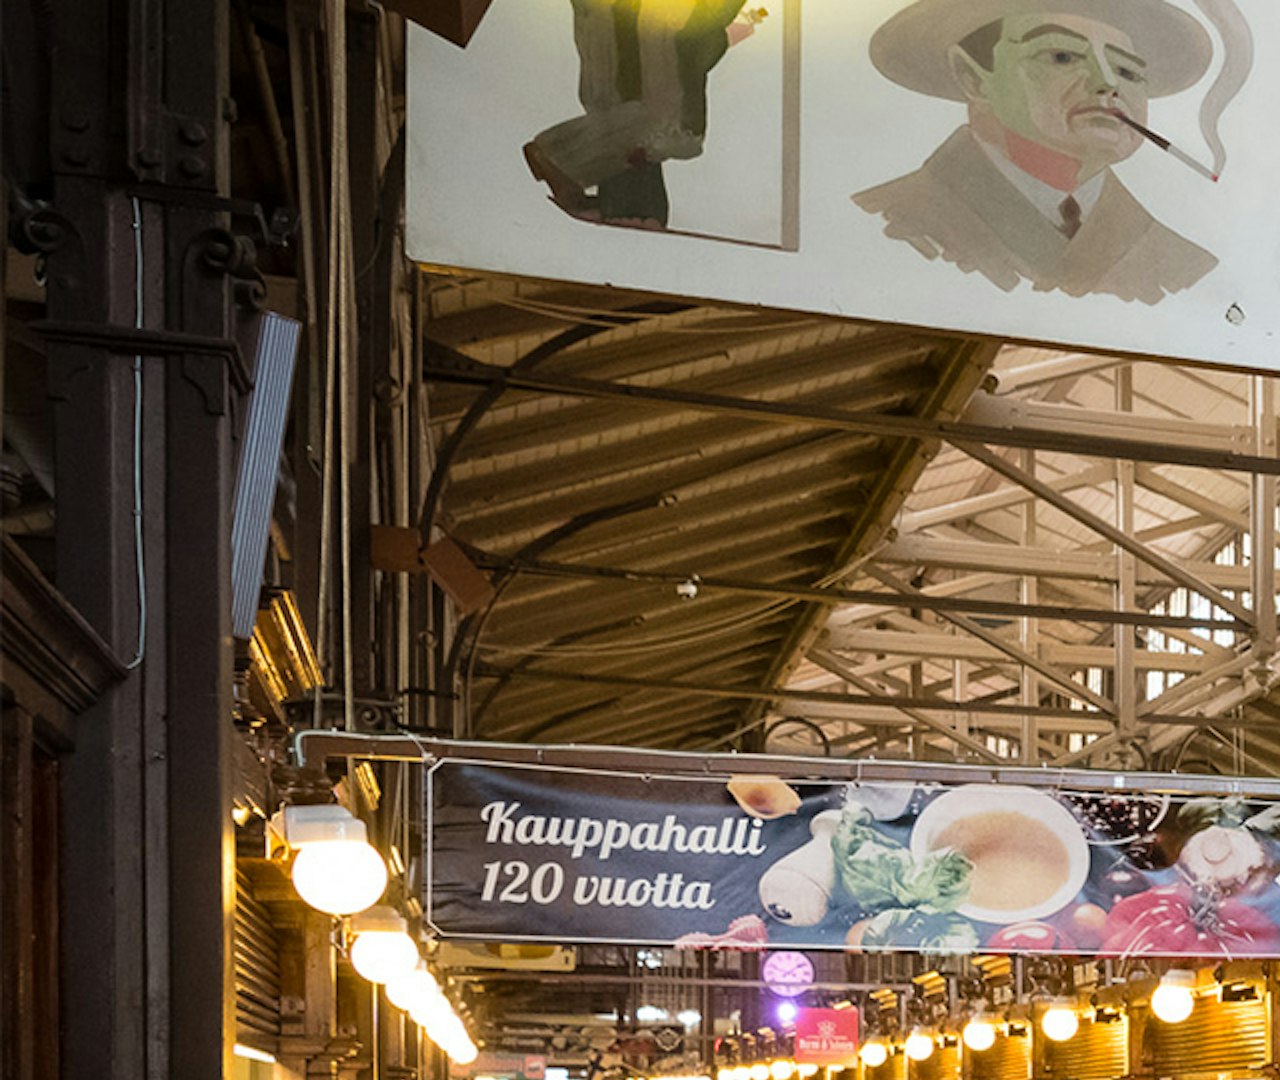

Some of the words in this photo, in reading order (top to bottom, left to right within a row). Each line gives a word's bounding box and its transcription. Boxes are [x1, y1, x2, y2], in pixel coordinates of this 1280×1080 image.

[480, 800, 766, 860] Kauppahalli
[480, 861, 564, 905] 120
[572, 872, 716, 911] vuotta
